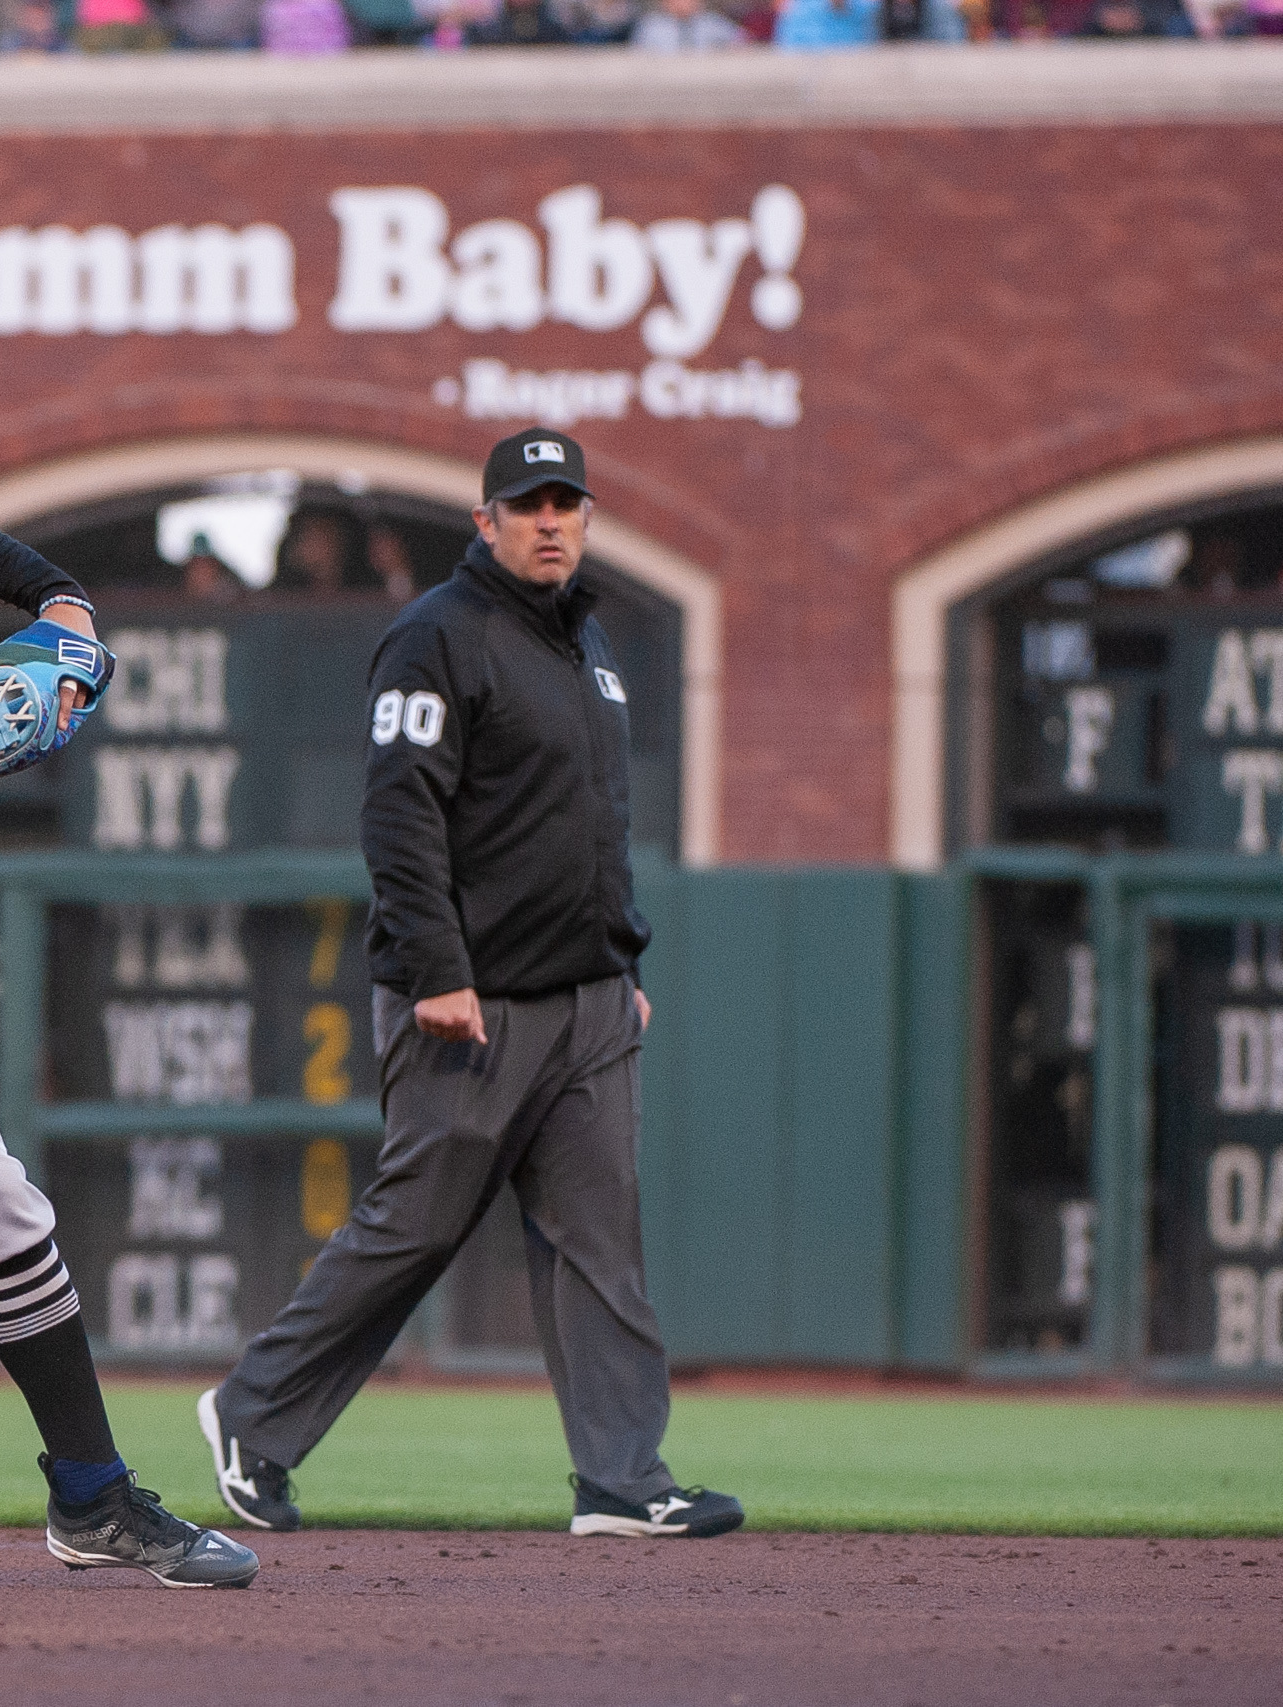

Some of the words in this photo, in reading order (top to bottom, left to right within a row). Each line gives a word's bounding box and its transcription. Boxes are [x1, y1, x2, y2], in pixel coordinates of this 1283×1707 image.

[328, 184, 807, 358] Baby!
[640, 357, 802, 428] Craig
[106, 628, 229, 734] CHI
[371, 688, 448, 748] 90
[1202, 627, 1283, 738] AT
[1062, 686, 1116, 796] F
[92, 744, 242, 852] NYY
[1221, 748, 1283, 856] T
[104, 1001, 254, 1105] WSH
[302, 1001, 353, 1106] 2
